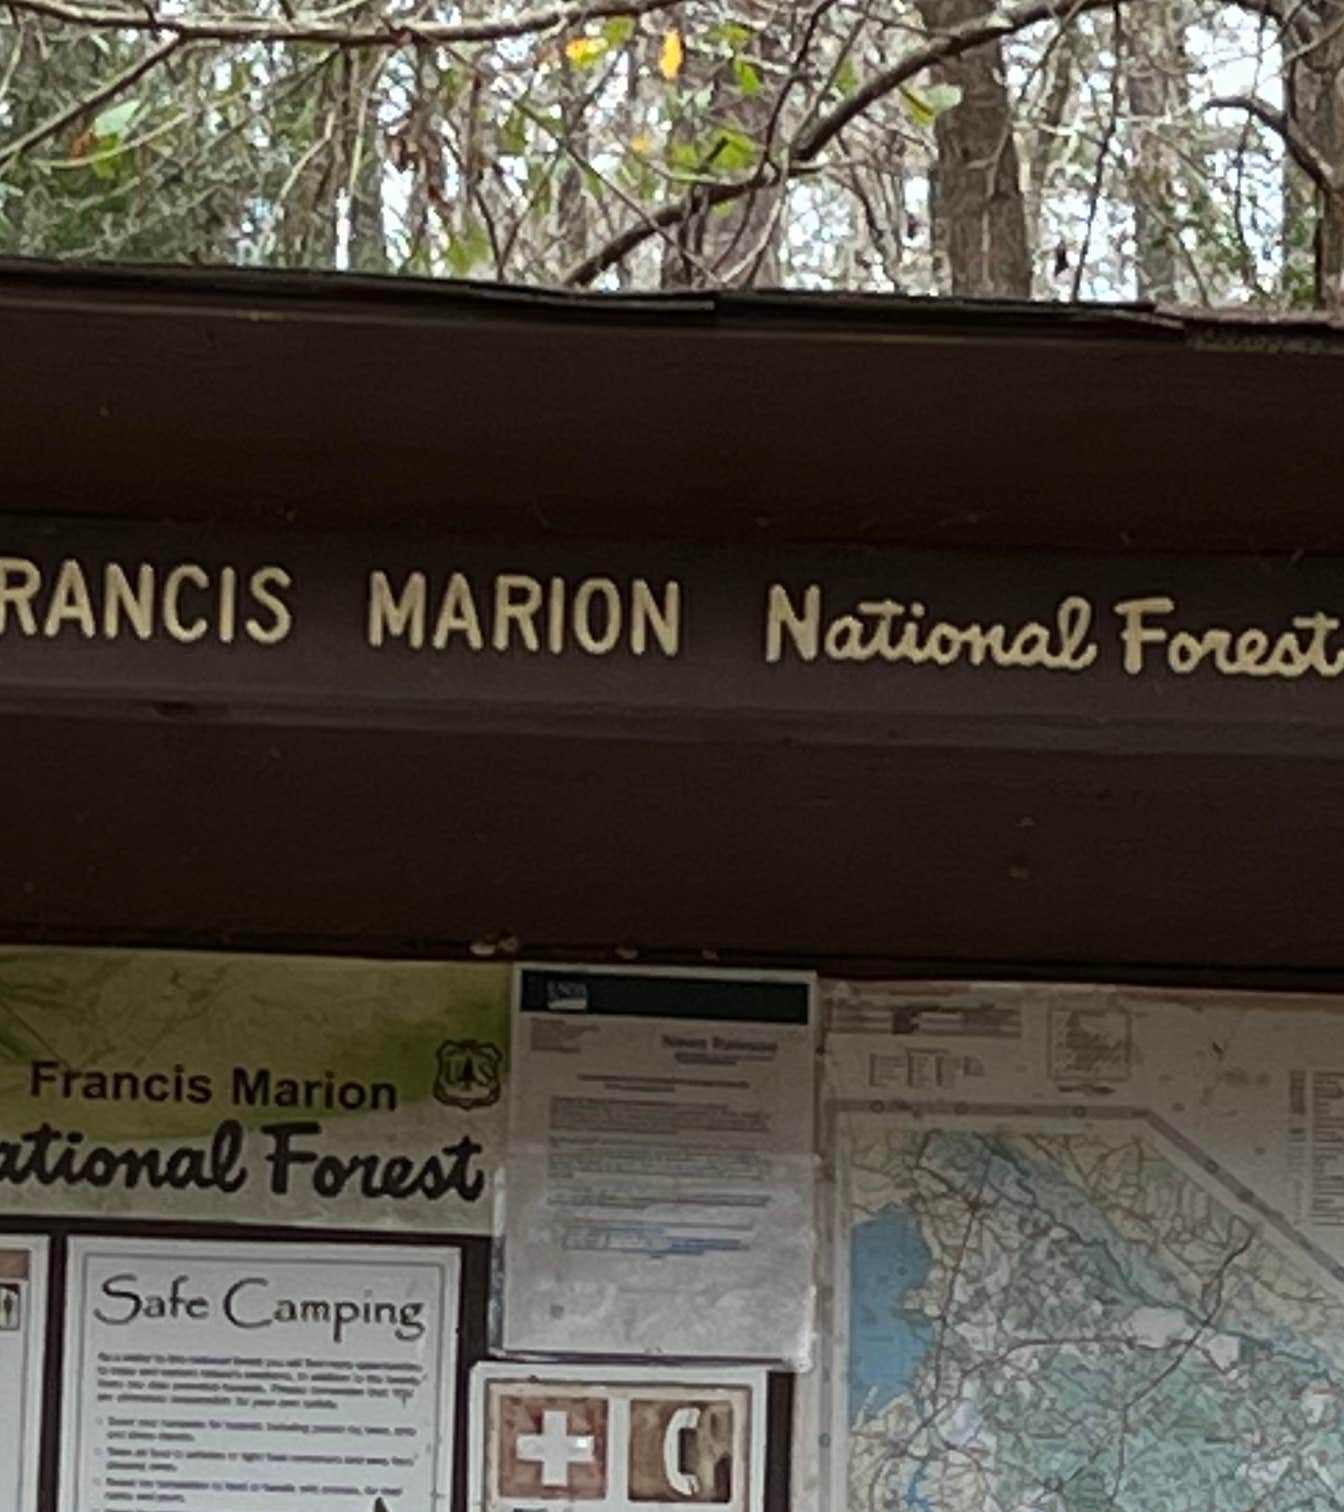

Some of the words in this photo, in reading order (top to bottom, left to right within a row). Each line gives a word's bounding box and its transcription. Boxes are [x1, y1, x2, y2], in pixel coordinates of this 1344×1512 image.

[368, 570, 680, 657] MARION
[764, 583, 1098, 671] National
[30, 1060, 213, 1103] Francis
[232, 1066, 397, 1111] Marion
[264, 1122, 484, 1202] Forest
[93, 1274, 209, 1326] Safe
[223, 1277, 425, 1343] Camping
